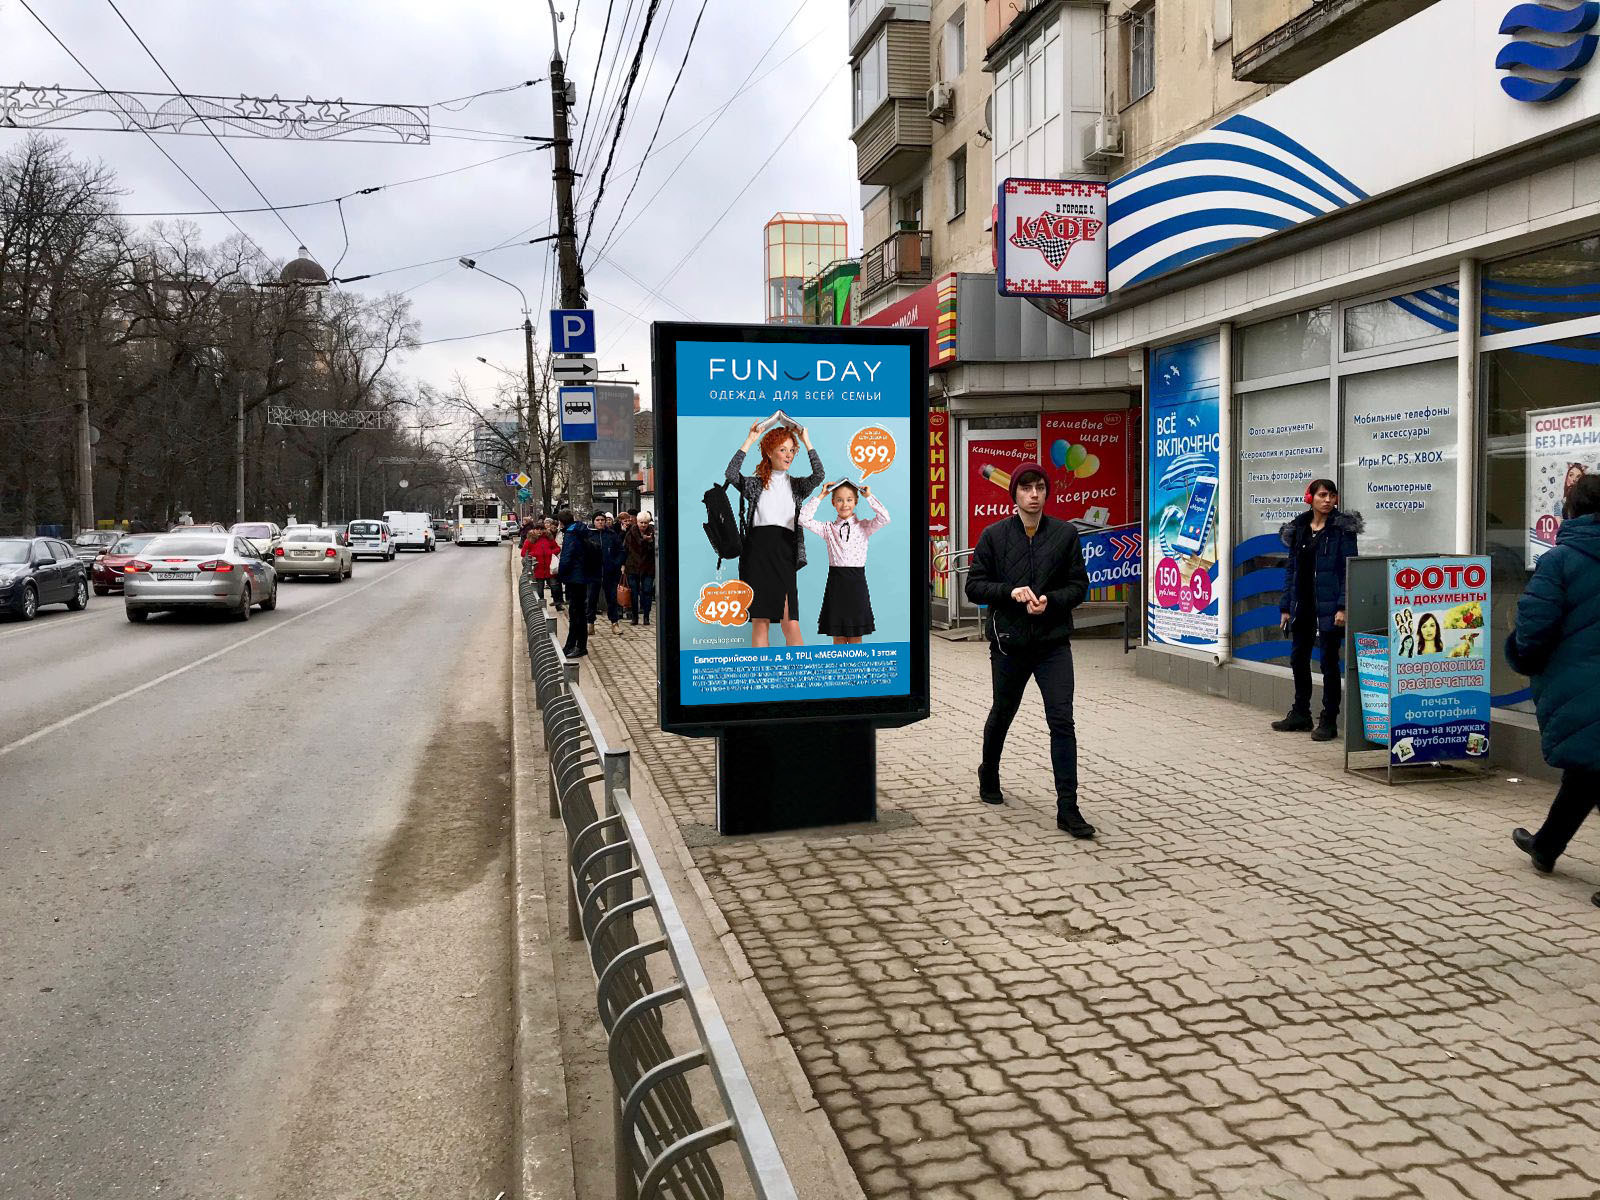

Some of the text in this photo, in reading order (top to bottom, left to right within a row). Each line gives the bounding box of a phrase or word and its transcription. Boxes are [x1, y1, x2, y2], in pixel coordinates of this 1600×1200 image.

[1056, 204, 1061, 213] В
[1062, 204, 1088, 215] ГОРОДЕ
[1016, 216, 1096, 241] КАФЕ
[709, 358, 882, 382] FUN DAY
[709, 389, 881, 401] ОДЕЖДА ДЛЯ ВСЕЙ СЕМЬИ
[1354, 405, 1450, 425] Мобильные телефоны
[1046, 418, 1103, 430] гелиевые
[1157, 412, 1176, 436] ВСЁ
[1249, 427, 1266, 436] Фото
[1276, 422, 1314, 435] документы
[1536, 415, 1592, 432] СОЦСЕТИ
[1080, 434, 1118, 446] шары
[1380, 427, 1430, 440] аксессуары
[1536, 431, 1600, 449] БЕЗ ГРАНИ
[1157, 432, 1220, 457] ВКЛЮЧЕНО
[972, 446, 1036, 461] канцтовары
[1240, 450, 1278, 460] Ксерокопия
[1285, 446, 1323, 459] распечатка
[1358, 456, 1380, 469] Игры
[1414, 451, 1443, 463] XBOX
[929, 431, 946, 517] КНИГИ
[1248, 469, 1312, 483] Печать фотографий
[1367, 481, 1432, 494] Компьютерные
[1056, 487, 1117, 504] ксерокс
[1250, 494, 1271, 504] Печать
[1282, 496, 1306, 506] кружк
[974, 503, 1020, 516] книг
[1376, 500, 1425, 512] аксессуары
[1541, 518, 1554, 533] 10
[1159, 567, 1178, 587] 150
[1394, 564, 1487, 591] ФОТО
[1193, 574, 1202, 599] 3
[1394, 592, 1487, 606] НА ДОКУМЕНТЫ
[694, 653, 758, 665] Евпаторийское
[795, 651, 812, 661] ТРЦ
[871, 649, 876, 657] 1
[877, 649, 897, 657] этаж
[1396, 659, 1486, 677] ксерокопия
[1398, 675, 1484, 694] распечатка
[1421, 697, 1461, 707] печать
[1404, 706, 1477, 722] фотографий
[1395, 727, 1429, 737] печать
[1431, 726, 1444, 734] на
[1446, 723, 1486, 735] кружках
[1413, 735, 1467, 748] футболках
